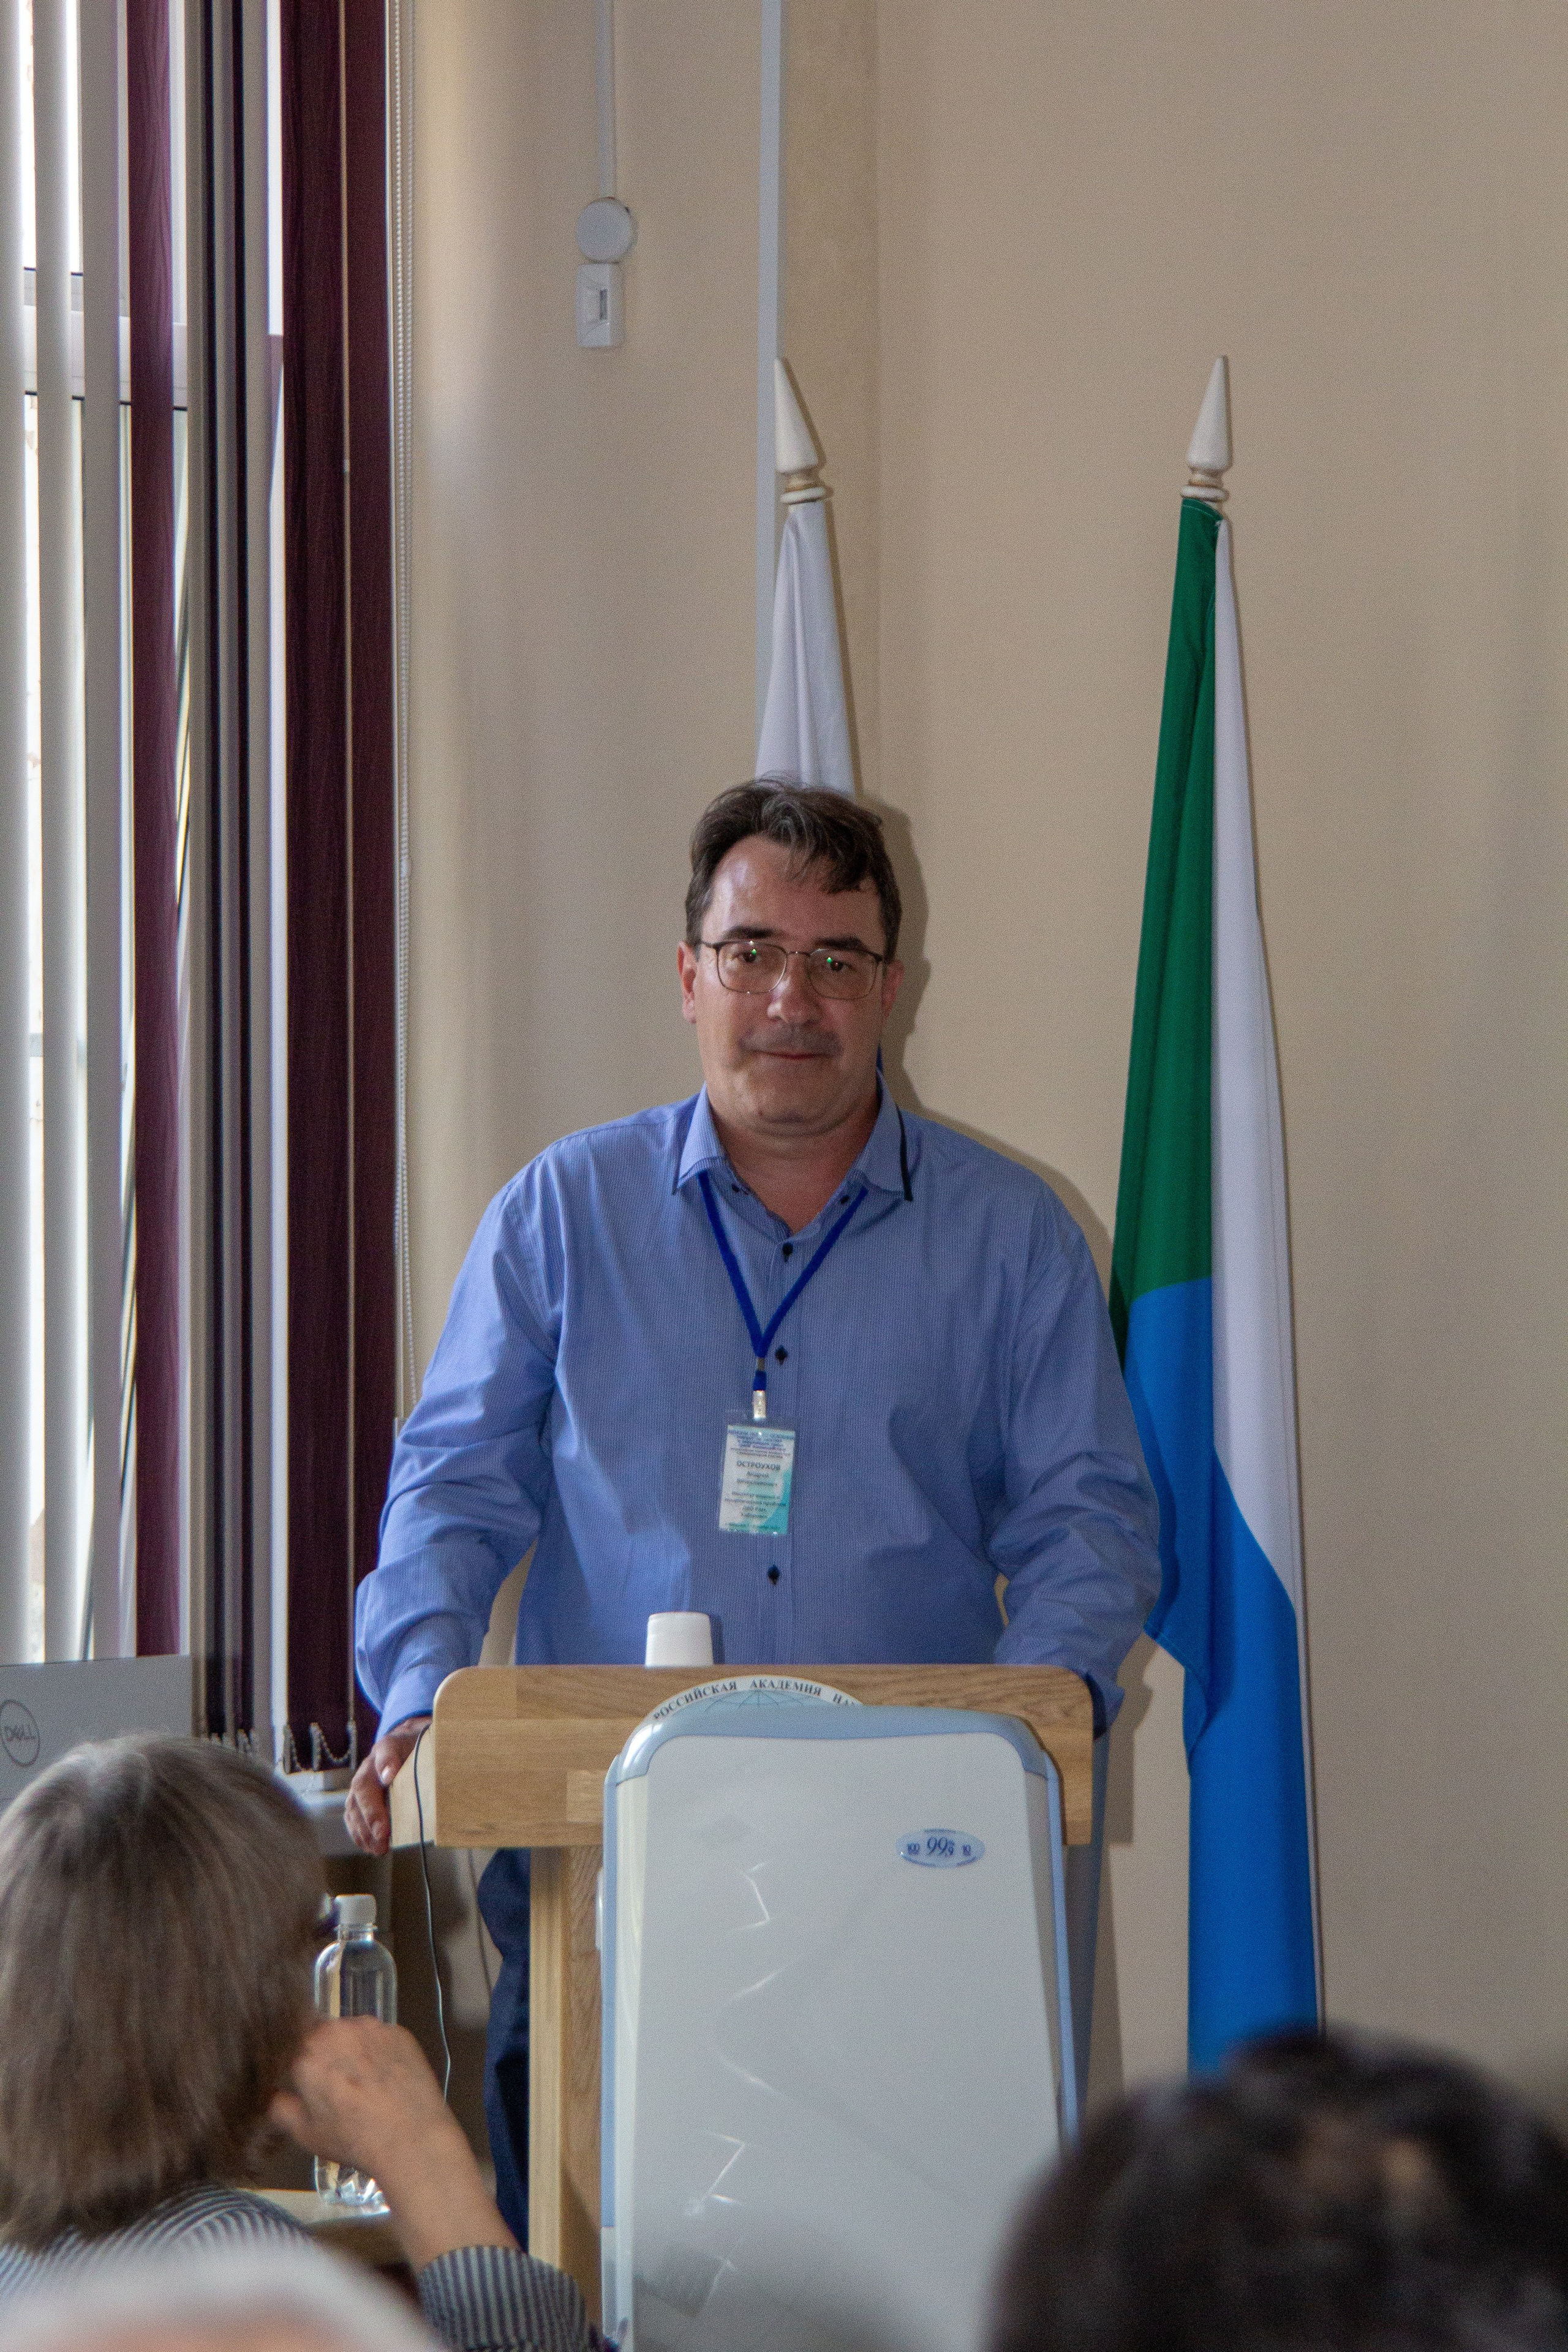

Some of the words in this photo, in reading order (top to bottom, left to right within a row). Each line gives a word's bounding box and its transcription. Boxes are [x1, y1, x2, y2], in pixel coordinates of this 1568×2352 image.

[652, 1680, 737, 1720] РОССИЙСКАЯ
[750, 1679, 822, 1697] АКАДЕМИЯ
[832, 1693, 855, 1706] НА
